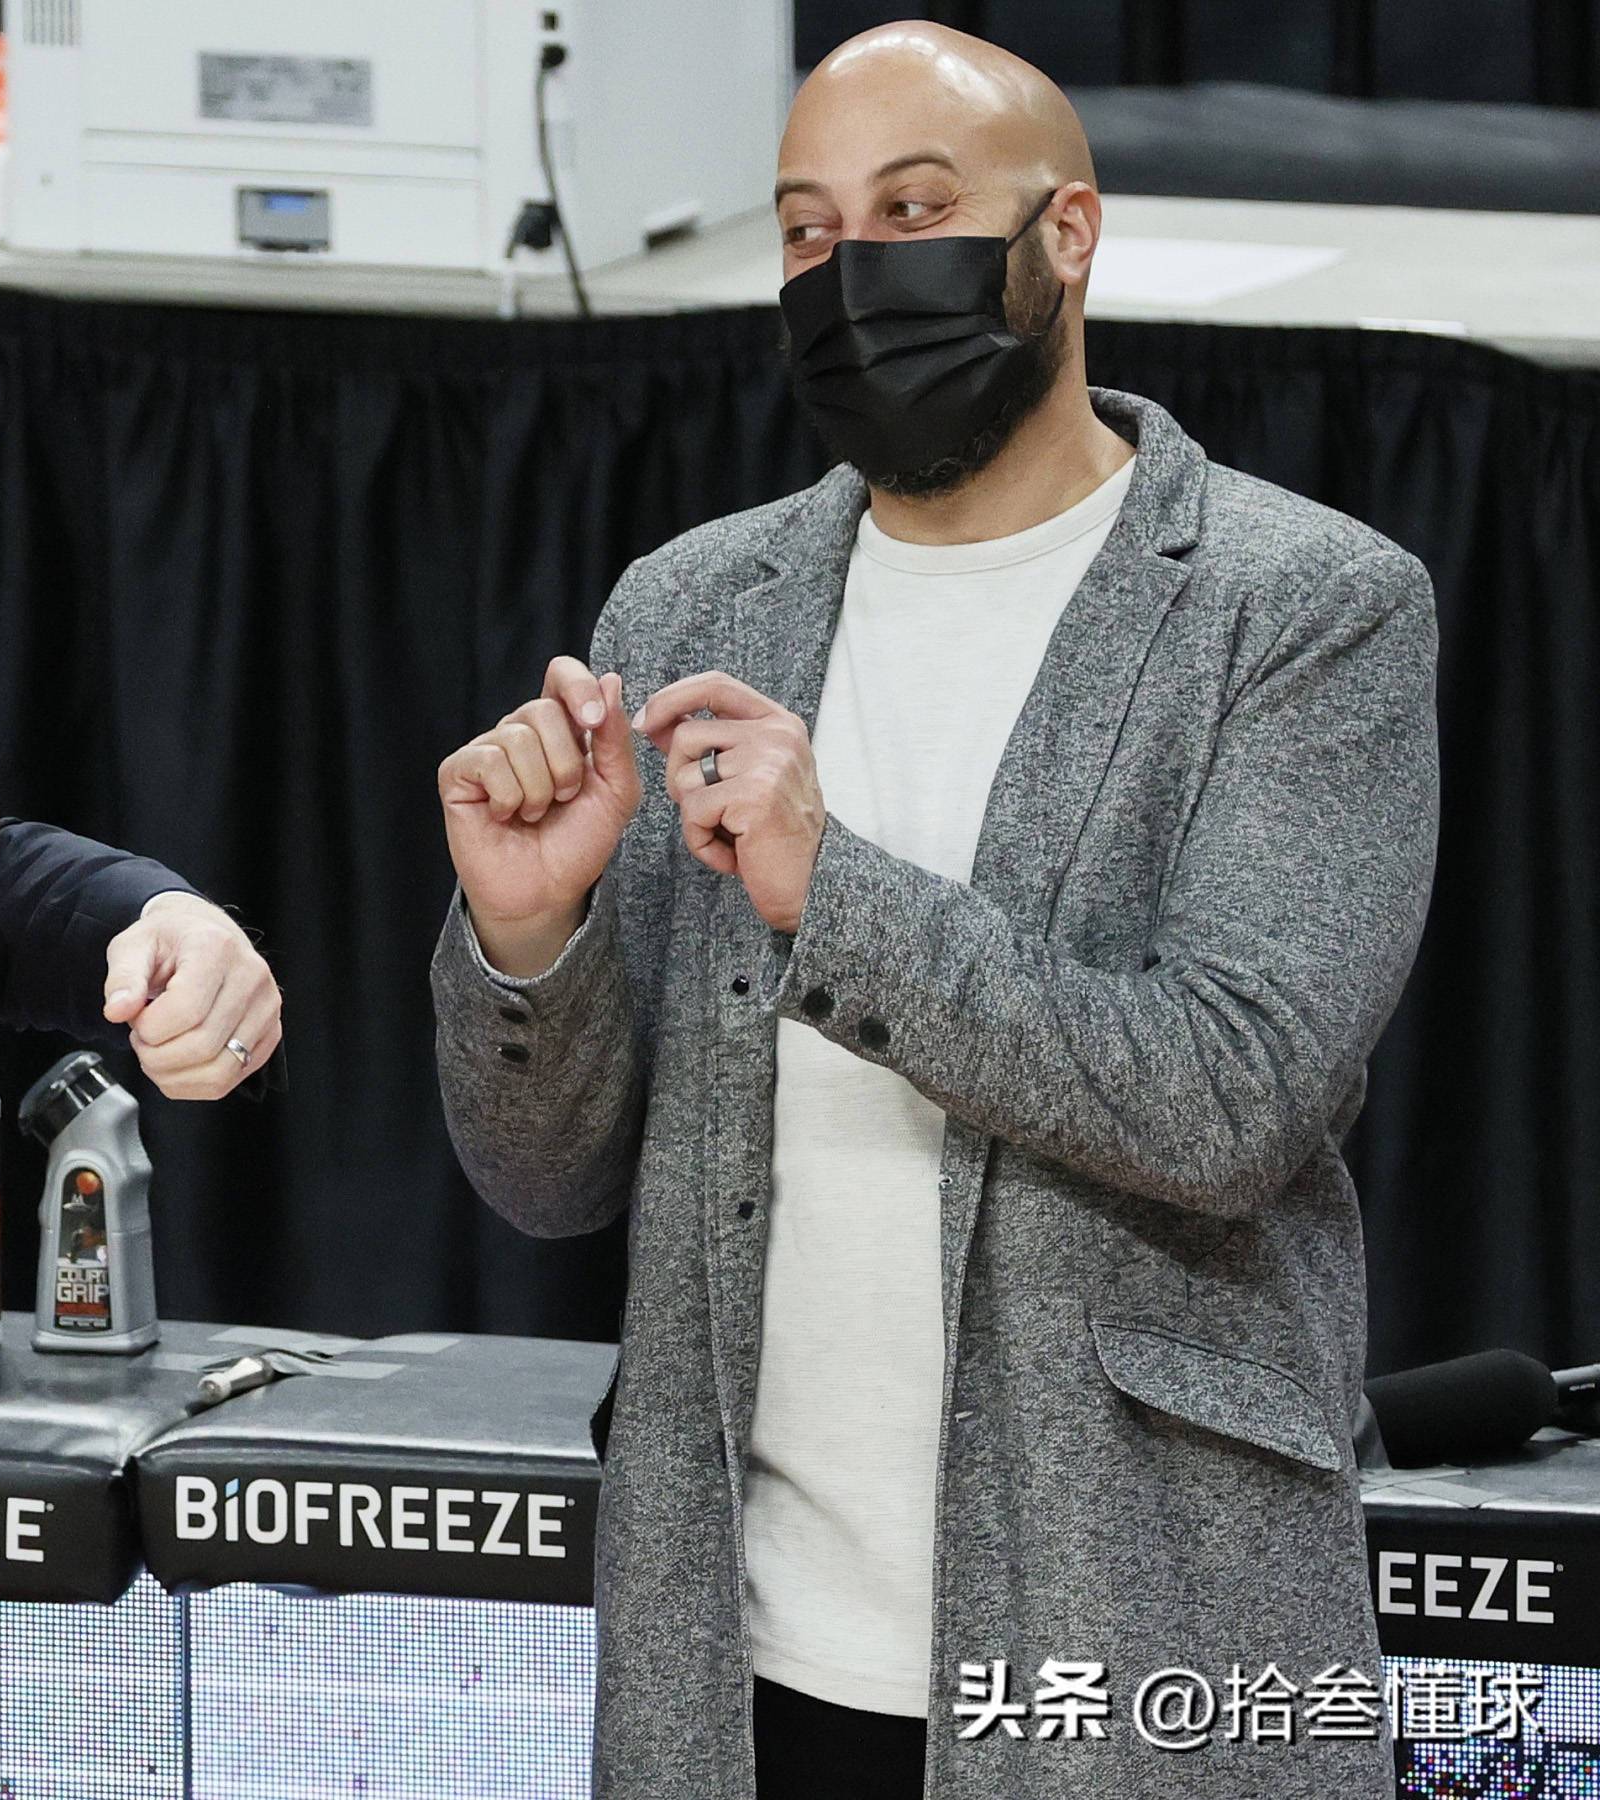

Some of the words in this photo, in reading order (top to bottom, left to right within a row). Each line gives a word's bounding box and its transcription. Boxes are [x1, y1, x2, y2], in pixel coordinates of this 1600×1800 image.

[57, 1268, 107, 1282] COURT
[57, 1282, 110, 1304] GRIP
[1378, 1551, 1555, 1624] EEZE
